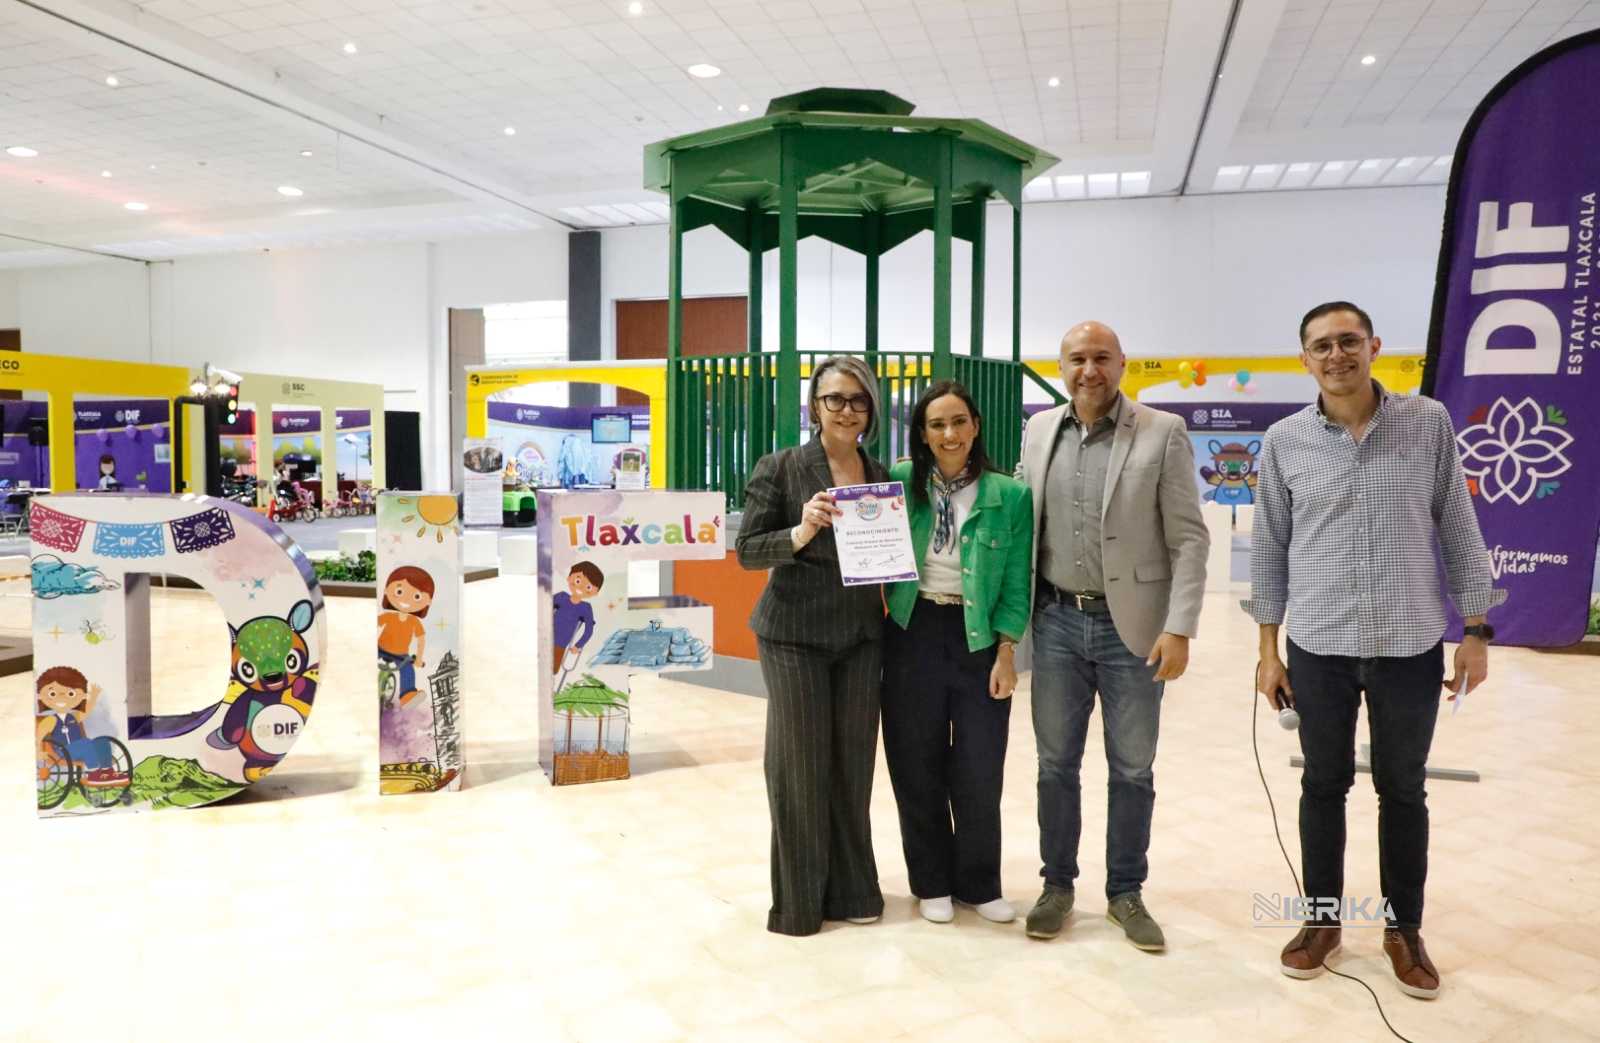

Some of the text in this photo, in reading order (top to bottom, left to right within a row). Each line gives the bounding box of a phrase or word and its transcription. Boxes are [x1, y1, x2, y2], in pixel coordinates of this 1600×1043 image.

[1464, 201, 1569, 376] DIF
[1567, 192, 1597, 375] ESTATAL TLAXCALA
[0, 360, 20, 370] CO
[1144, 360, 1162, 369] SIA
[125, 410, 140, 420] DIF
[1211, 409, 1233, 418] SIA
[560, 513, 718, 547] Tlaxcala
[119, 536, 137, 547] DIF
[1488, 544, 1569, 565] formamos
[273, 722, 299, 736] DIF
